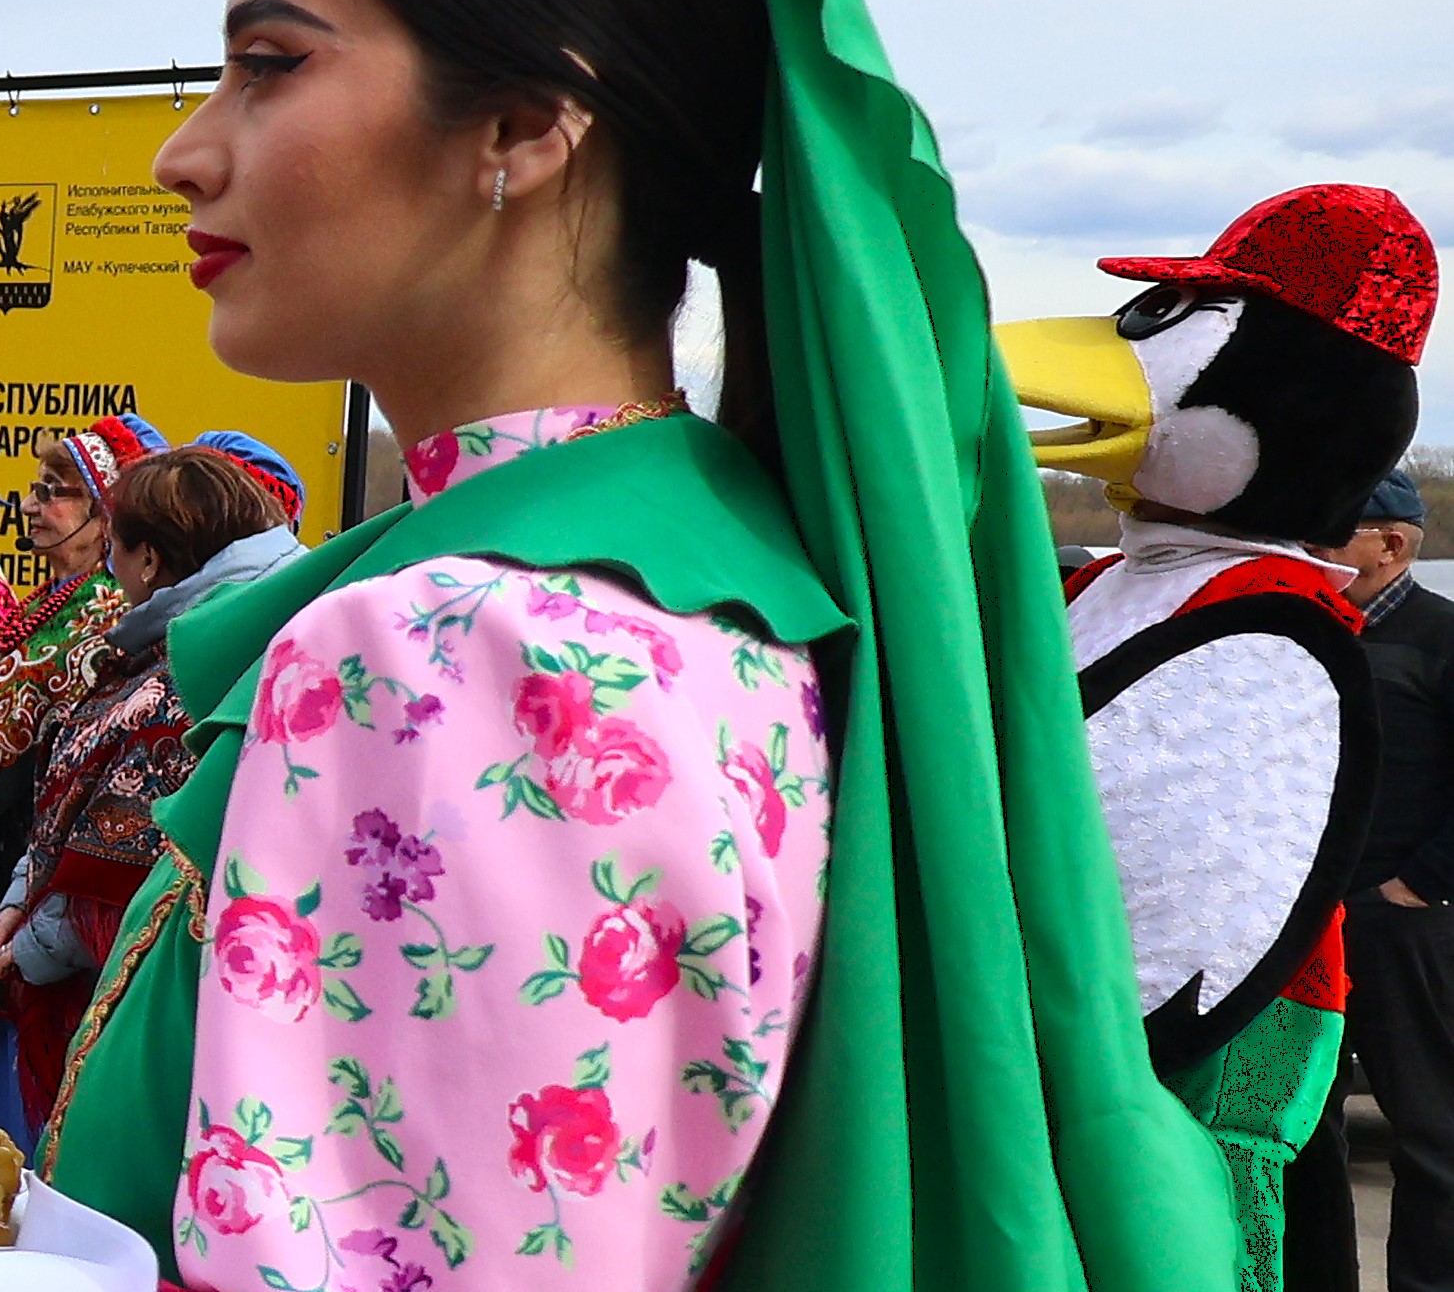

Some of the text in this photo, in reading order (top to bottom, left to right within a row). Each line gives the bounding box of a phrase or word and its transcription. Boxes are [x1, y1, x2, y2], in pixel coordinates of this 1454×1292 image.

[66, 202, 149, 219] Елабужского
[65, 222, 140, 239] Республики
[63, 261, 93, 274] МАУ
